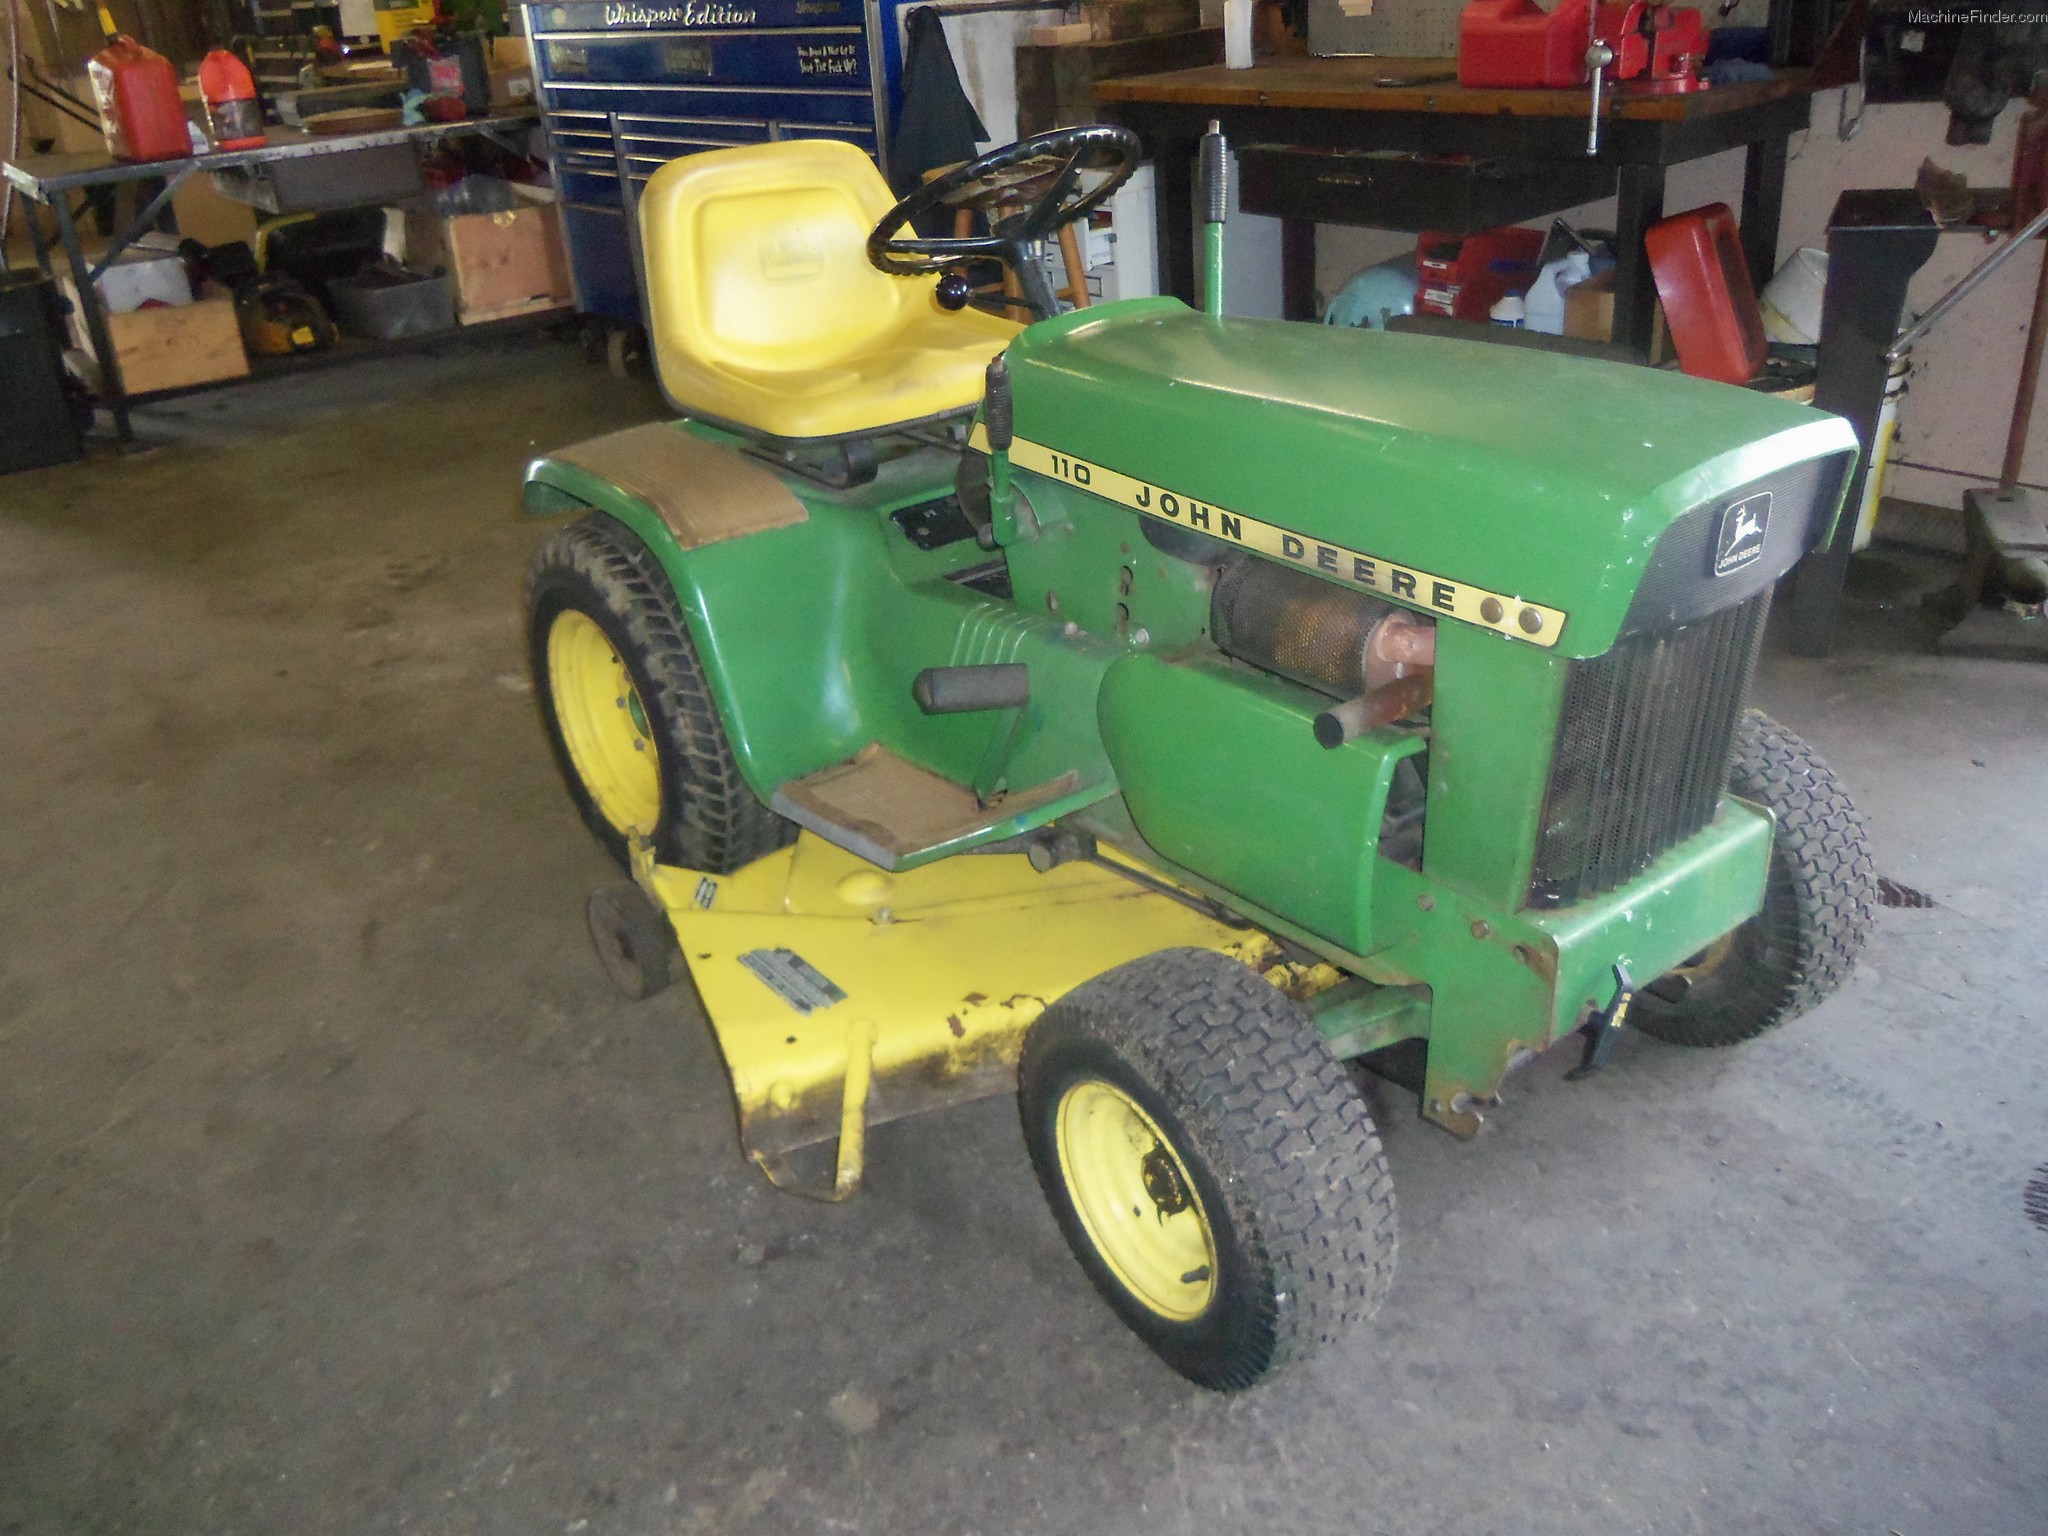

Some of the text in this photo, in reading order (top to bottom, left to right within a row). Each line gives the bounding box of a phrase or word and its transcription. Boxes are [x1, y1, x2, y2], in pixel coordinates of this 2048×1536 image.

[604, 0, 757, 28] Whisper Edition
[1051, 454, 1457, 613] 110 JOHN DEERE
